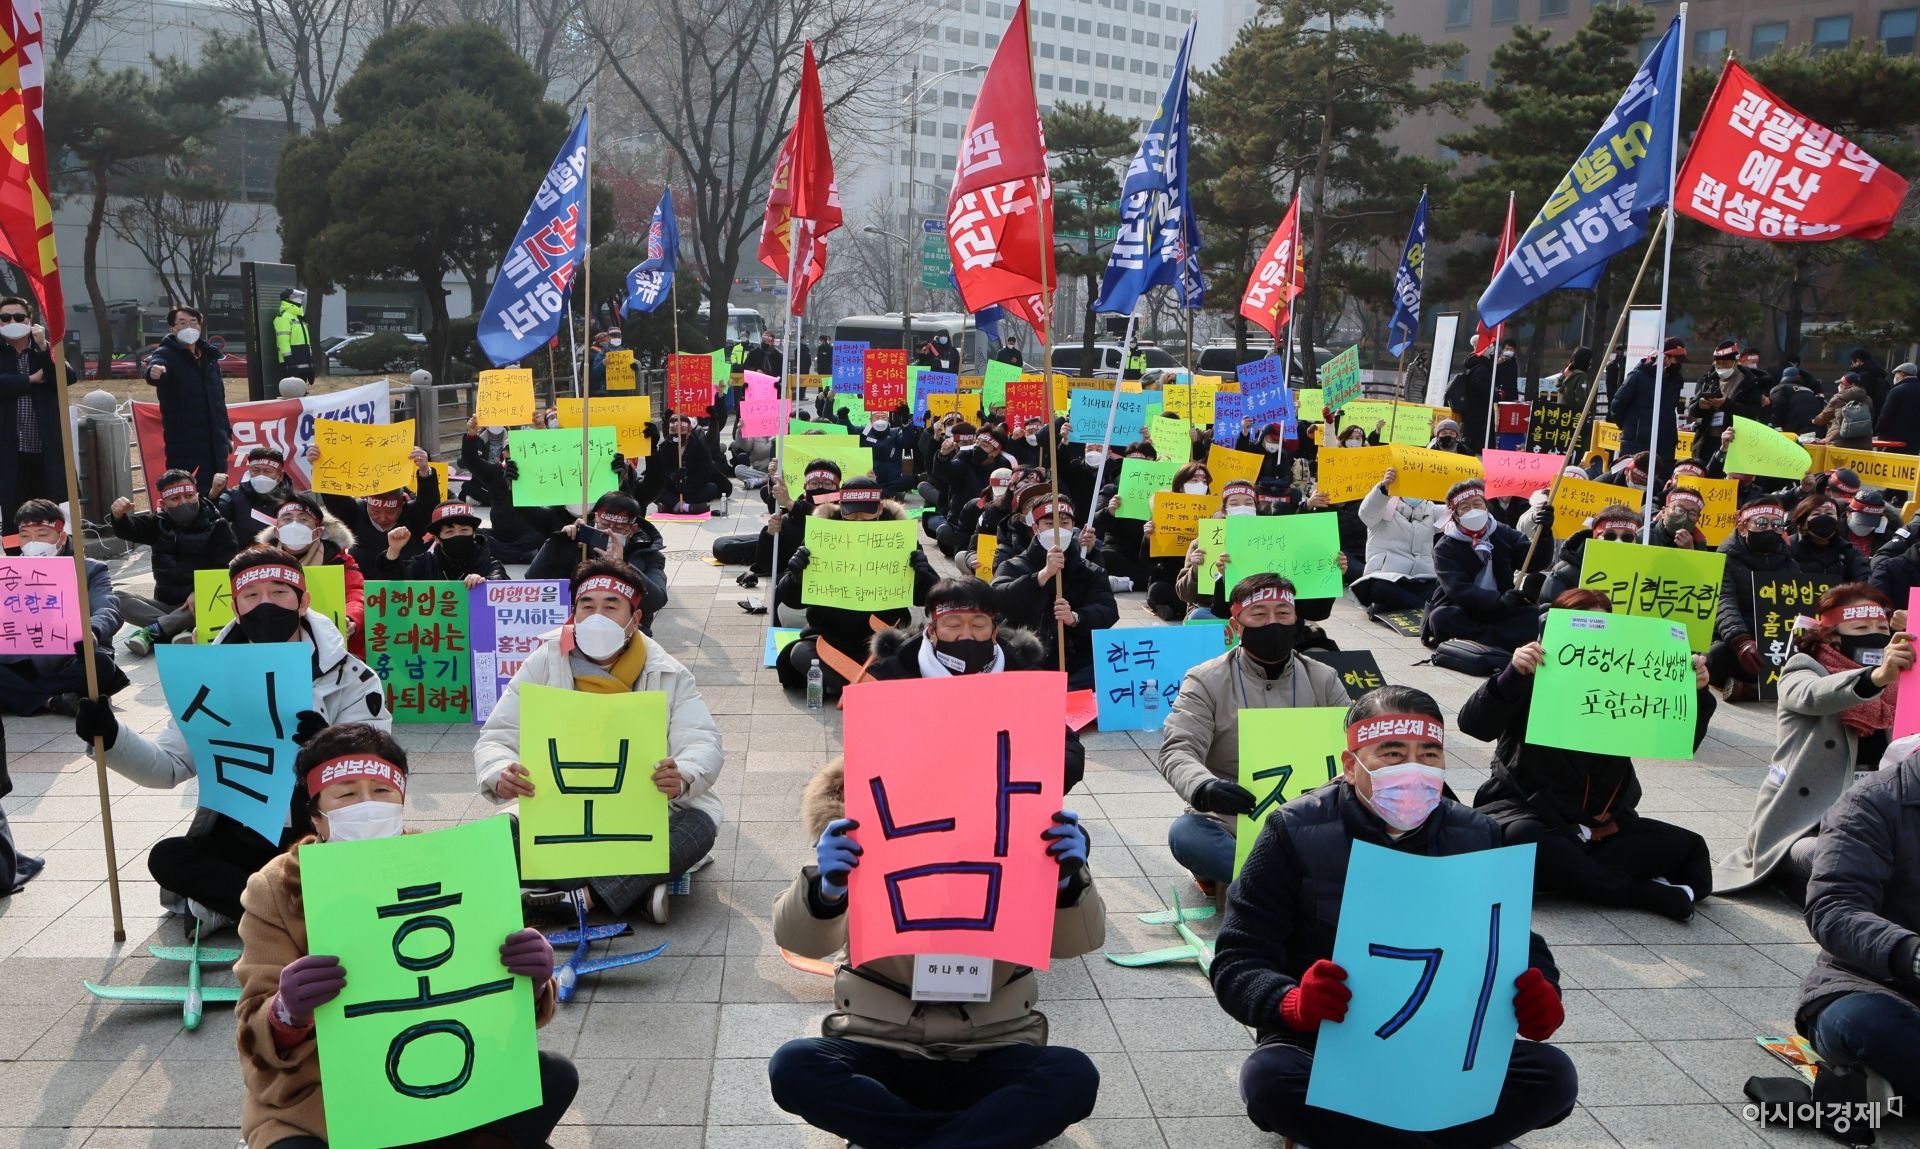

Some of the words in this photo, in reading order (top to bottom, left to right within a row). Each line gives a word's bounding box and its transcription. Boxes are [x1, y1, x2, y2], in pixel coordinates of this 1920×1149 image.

[1737, 150, 1821, 211] 예산
[871, 383, 904, 397] 홍남기
[1247, 388, 1281, 410] 홍남기
[232, 418, 290, 467] 유지
[1850, 460, 1889, 478] POLICE
[1892, 464, 1915, 480] LINE
[810, 530, 850, 549] 여행사
[858, 533, 904, 549] 대표님들
[1248, 535, 1285, 550] 여행업
[236, 567, 281, 590] 손실보상제
[283, 569, 300, 585] 포함
[810, 557, 862, 577] 포기하지
[367, 585, 459, 617] 여행업을
[488, 585, 560, 603] 여행업을
[613, 582, 634, 598] 지원
[807, 581, 850, 598] 하나투어도
[855, 583, 911, 602] 함께합니다!
[4, 591, 64, 618] 연합회
[497, 607, 566, 625] 무시하는
[0, 621, 69, 649] 특별시
[367, 623, 466, 653] 홀대하는
[374, 654, 458, 681] 홍남기
[1107, 640, 1160, 672] 한국
[1559, 644, 1635, 675] 여행사
[1637, 650, 1687, 682] 손실보상법
[1344, 671, 1381, 689] 하는
[1581, 689, 1687, 721] 포함하라!!!
[181, 671, 284, 804] 실
[1357, 719, 1423, 741] 손실보상제
[1427, 719, 1444, 741] 포함
[321, 760, 391, 783] 손실보상제
[534, 737, 654, 845] 보
[868, 729, 1042, 934] 남
[928, 964, 979, 975] 하나투어
[343, 881, 516, 1099] 홍
[1368, 901, 1502, 1072] 기
